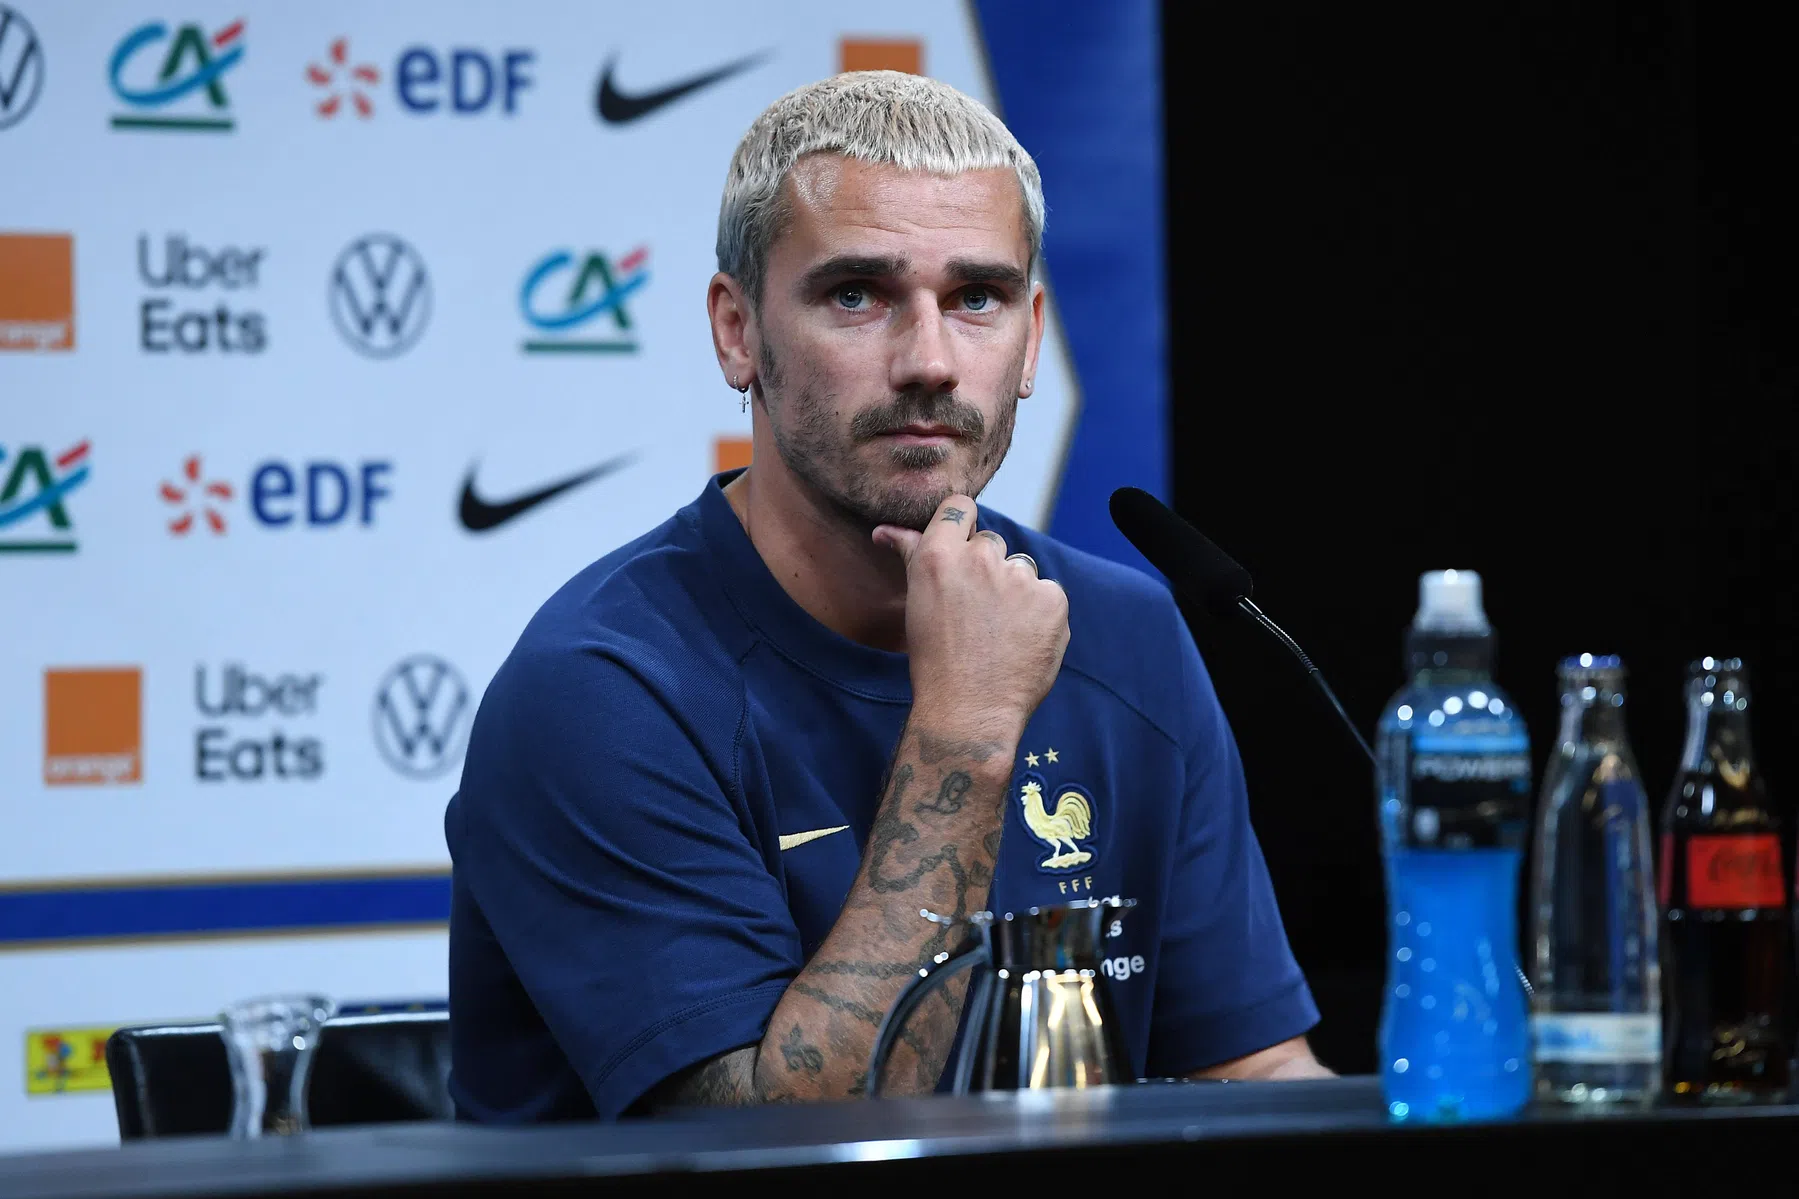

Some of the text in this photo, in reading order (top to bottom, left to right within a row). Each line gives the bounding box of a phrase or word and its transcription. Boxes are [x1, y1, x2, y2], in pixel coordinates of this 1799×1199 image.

[137, 232, 267, 290] Uber
[139, 297, 268, 355] Eats
[193, 662, 322, 719] Uber
[194, 726, 324, 783] Eats
